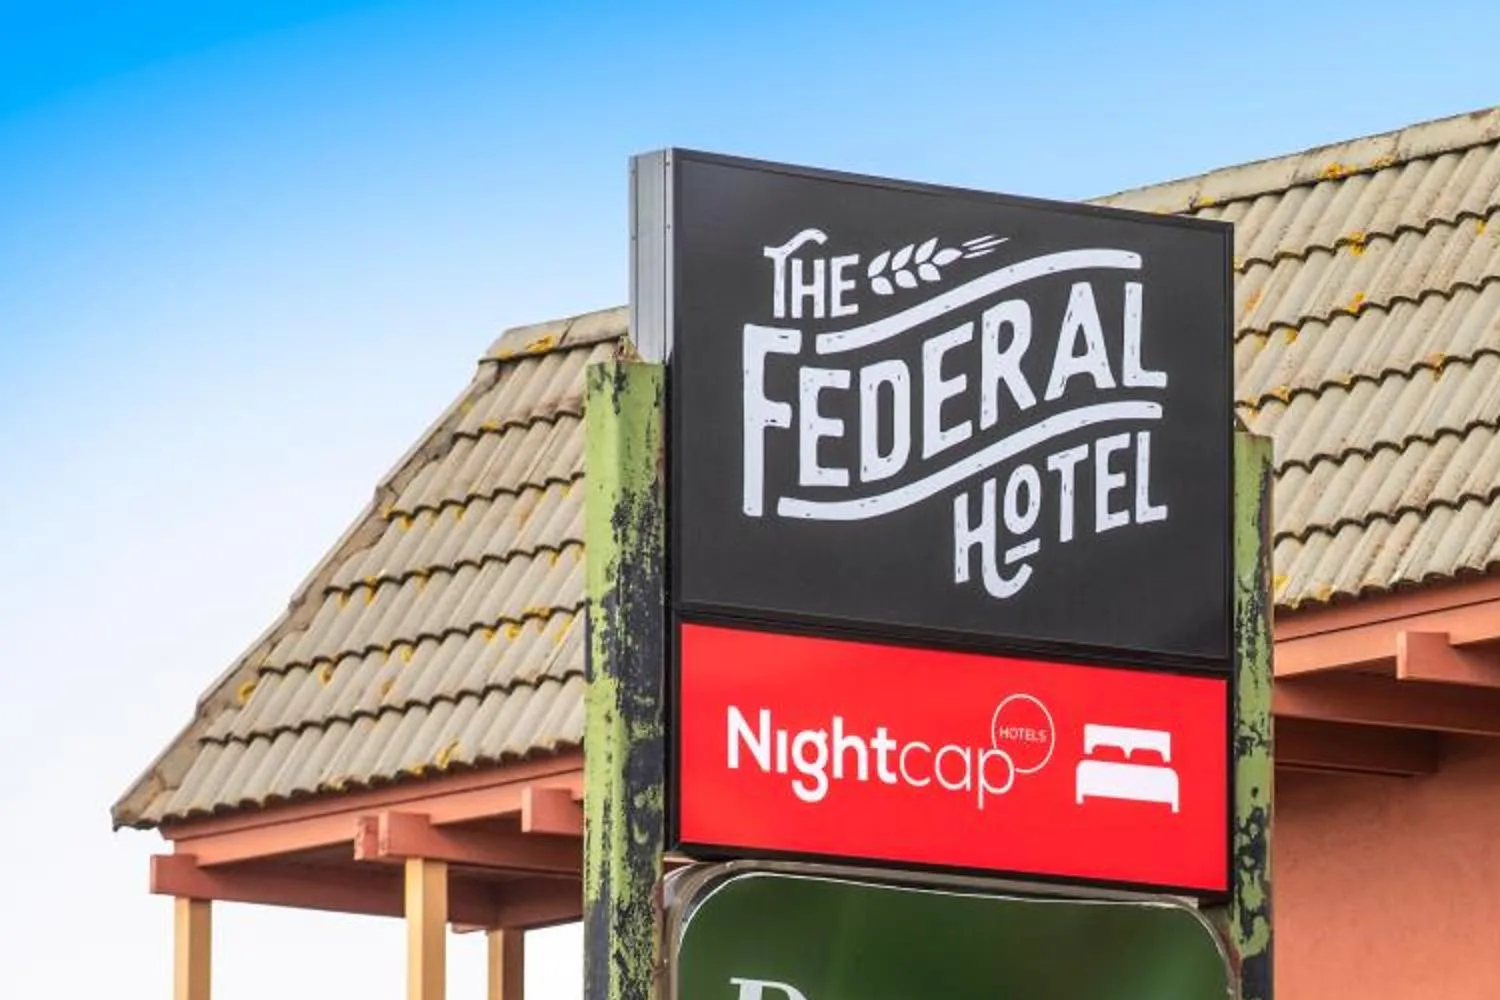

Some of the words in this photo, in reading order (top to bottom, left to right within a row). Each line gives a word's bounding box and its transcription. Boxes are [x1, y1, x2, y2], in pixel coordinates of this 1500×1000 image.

[764, 228, 859, 319] THE
[742, 281, 1168, 518] FEDERAL
[954, 430, 1168, 598] HOTEL
[727, 705, 1015, 810] Nightcap
[999, 726, 1047, 744] HOTELS
